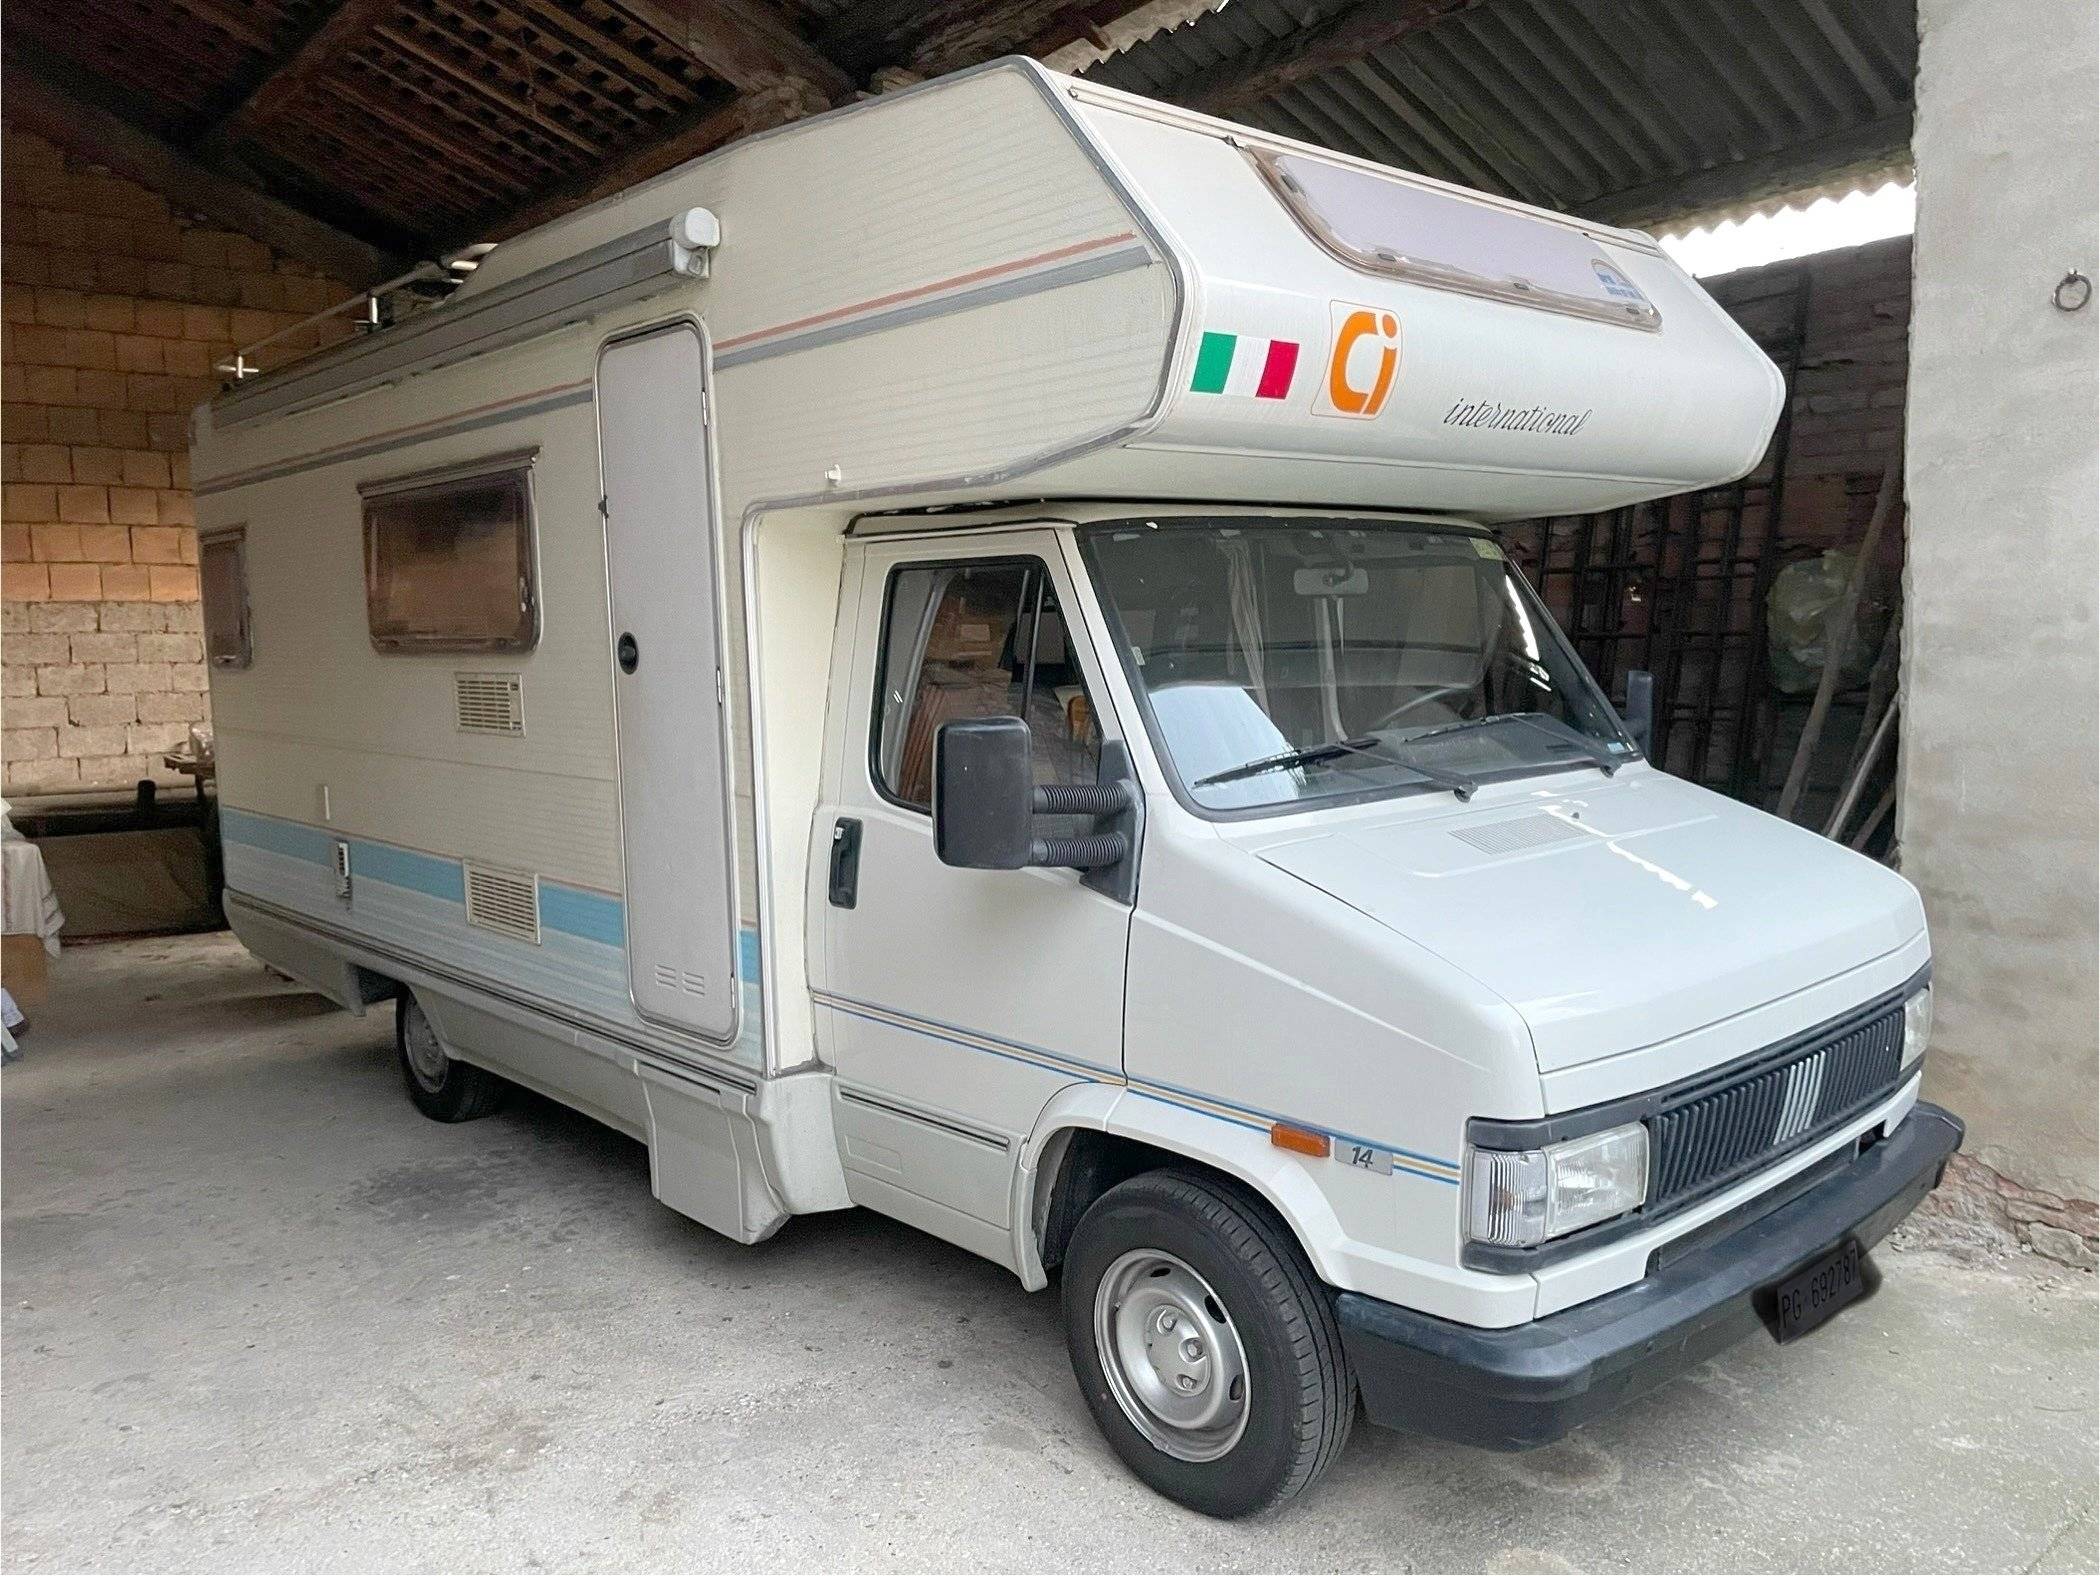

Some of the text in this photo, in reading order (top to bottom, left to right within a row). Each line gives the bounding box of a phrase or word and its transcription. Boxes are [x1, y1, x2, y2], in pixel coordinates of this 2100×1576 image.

[1443, 397, 1593, 435] international
[1352, 1146, 1373, 1168] 14
[1781, 1288, 1802, 1329] PG
